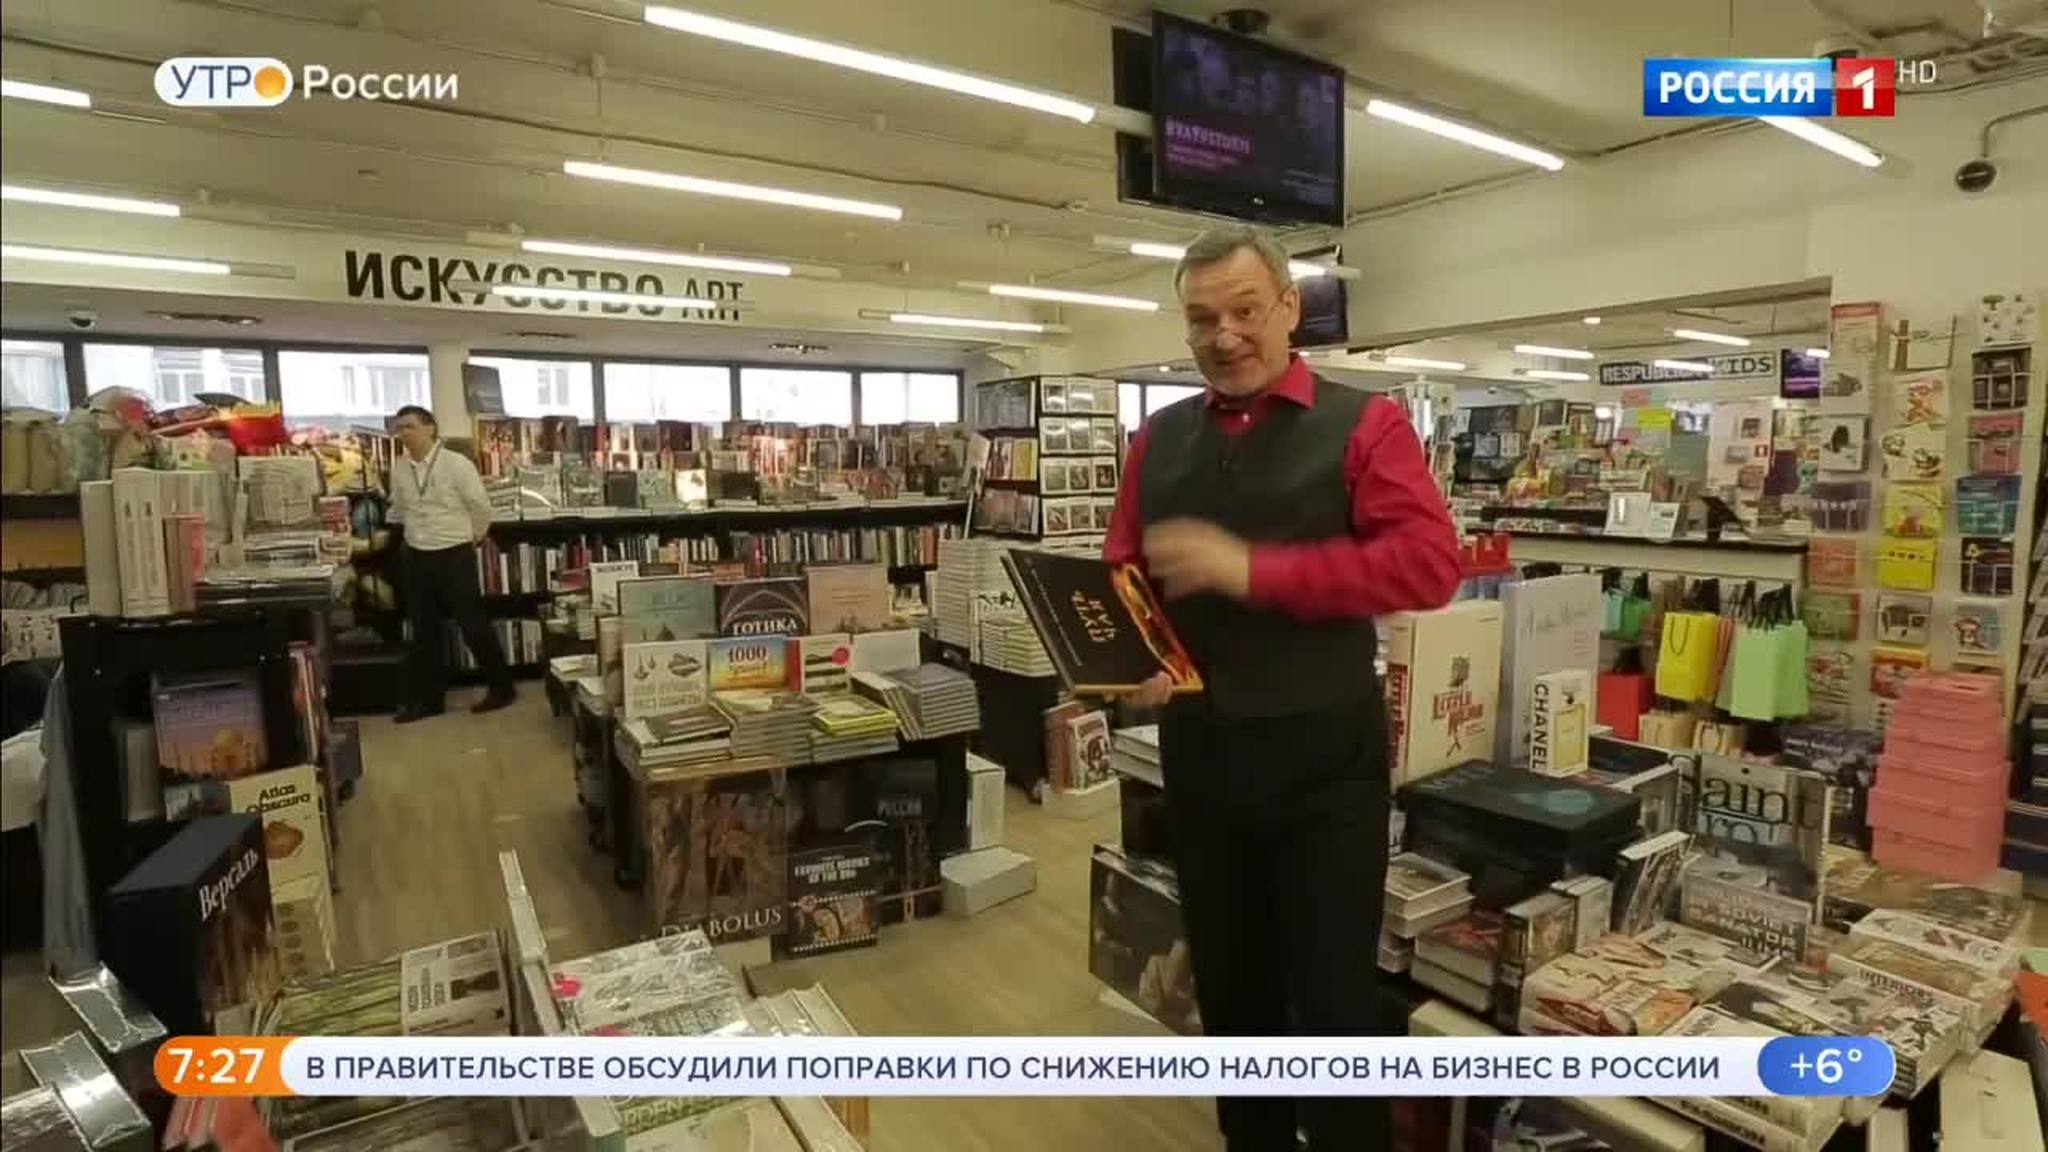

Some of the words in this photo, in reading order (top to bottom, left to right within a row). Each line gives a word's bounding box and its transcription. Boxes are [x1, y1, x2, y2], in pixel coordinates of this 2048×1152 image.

[344, 250, 663, 316] ИСКУССТВО
[681, 278, 743, 321] ART
[728, 646, 768, 663] 1000
[1531, 683, 1549, 769] CHANEL
[199, 847, 260, 923] Версаль
